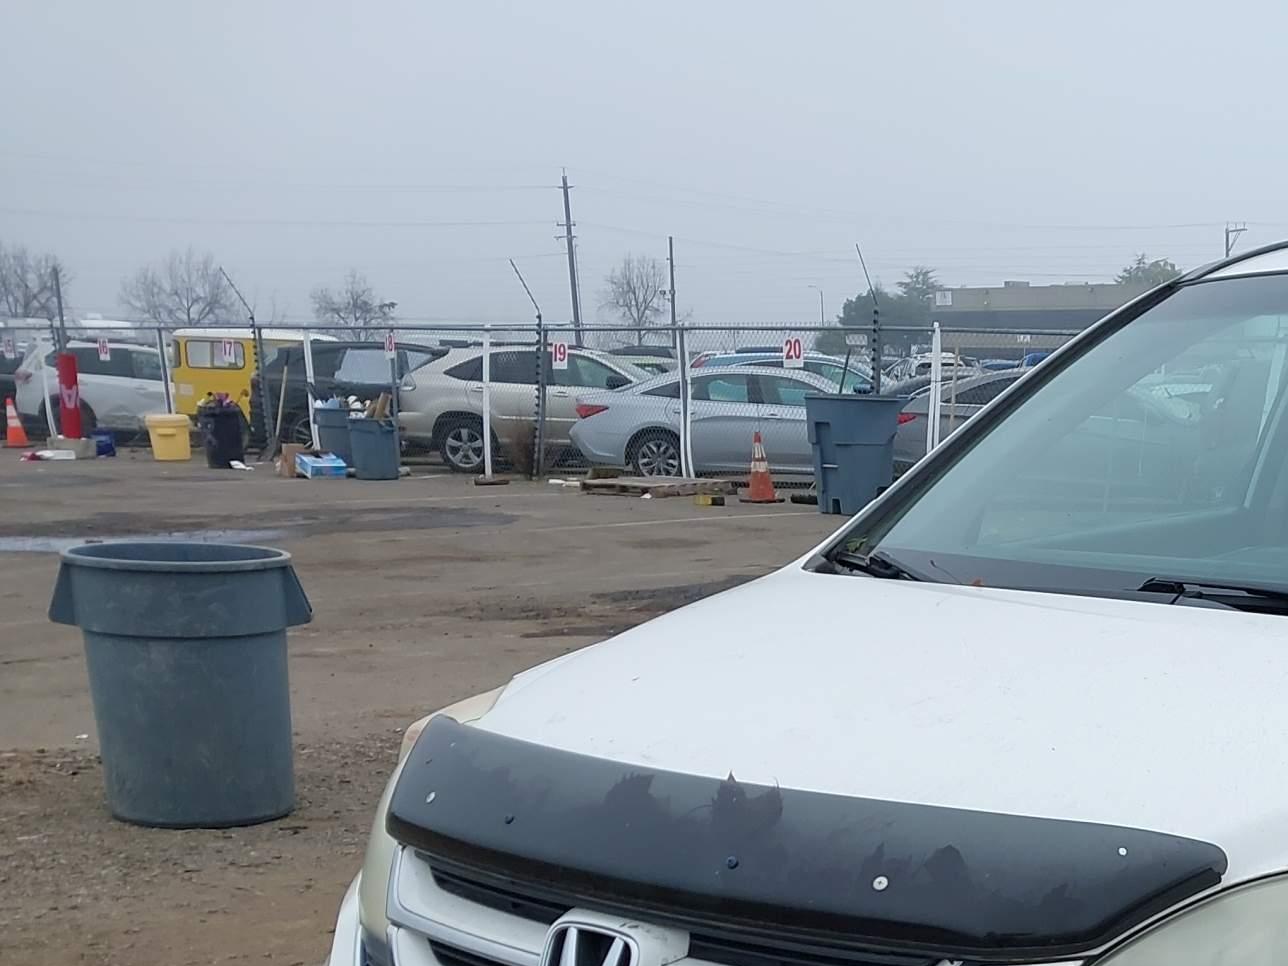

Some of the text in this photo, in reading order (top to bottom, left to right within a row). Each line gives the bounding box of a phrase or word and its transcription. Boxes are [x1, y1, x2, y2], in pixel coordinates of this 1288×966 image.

[223, 340, 233, 357] 17
[554, 343, 567, 362] 19
[785, 338, 802, 360] 20
